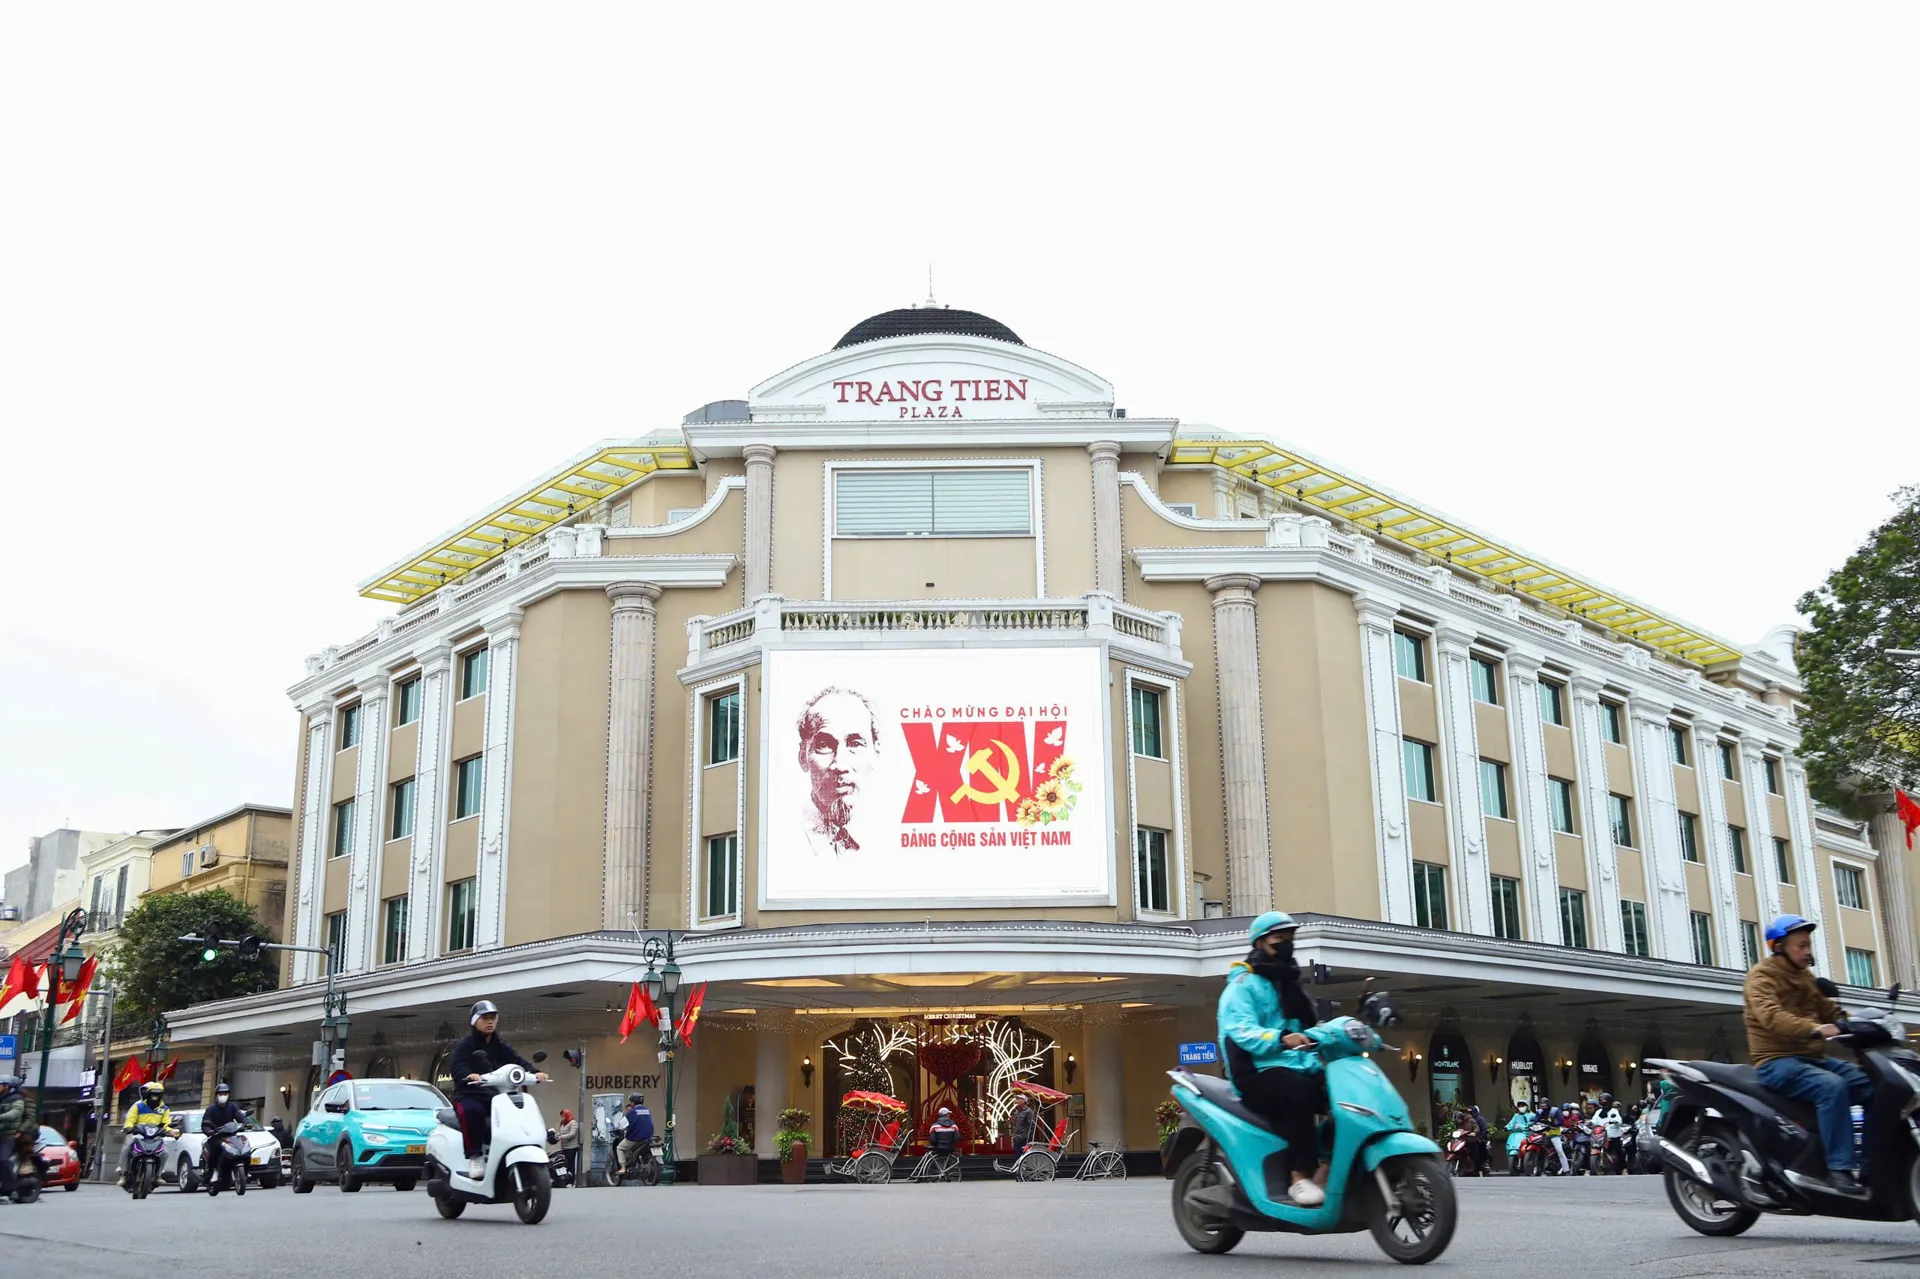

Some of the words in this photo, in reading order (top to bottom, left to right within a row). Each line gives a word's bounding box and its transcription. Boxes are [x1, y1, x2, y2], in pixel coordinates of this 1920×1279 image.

[833, 380, 943, 406] TRANG
[951, 379, 1028, 401] TIEN
[899, 406, 963, 418] PLAZA
[900, 705, 946, 718] CHÀO
[952, 704, 999, 718] MỪNG
[1005, 706, 1033, 720] ĐẠI
[1039, 704, 1067, 720] HỘI
[900, 828, 936, 847] ĐẢNG
[940, 829, 976, 850] CỘNG
[980, 827, 1007, 847] SẢN
[1010, 828, 1037, 849] VIỆT
[1041, 831, 1071, 846] NAM
[1434, 1060, 1459, 1068] MONTBLANC
[1511, 1061, 1533, 1070] HUBLOT
[586, 1075, 660, 1089] BURBERRY
